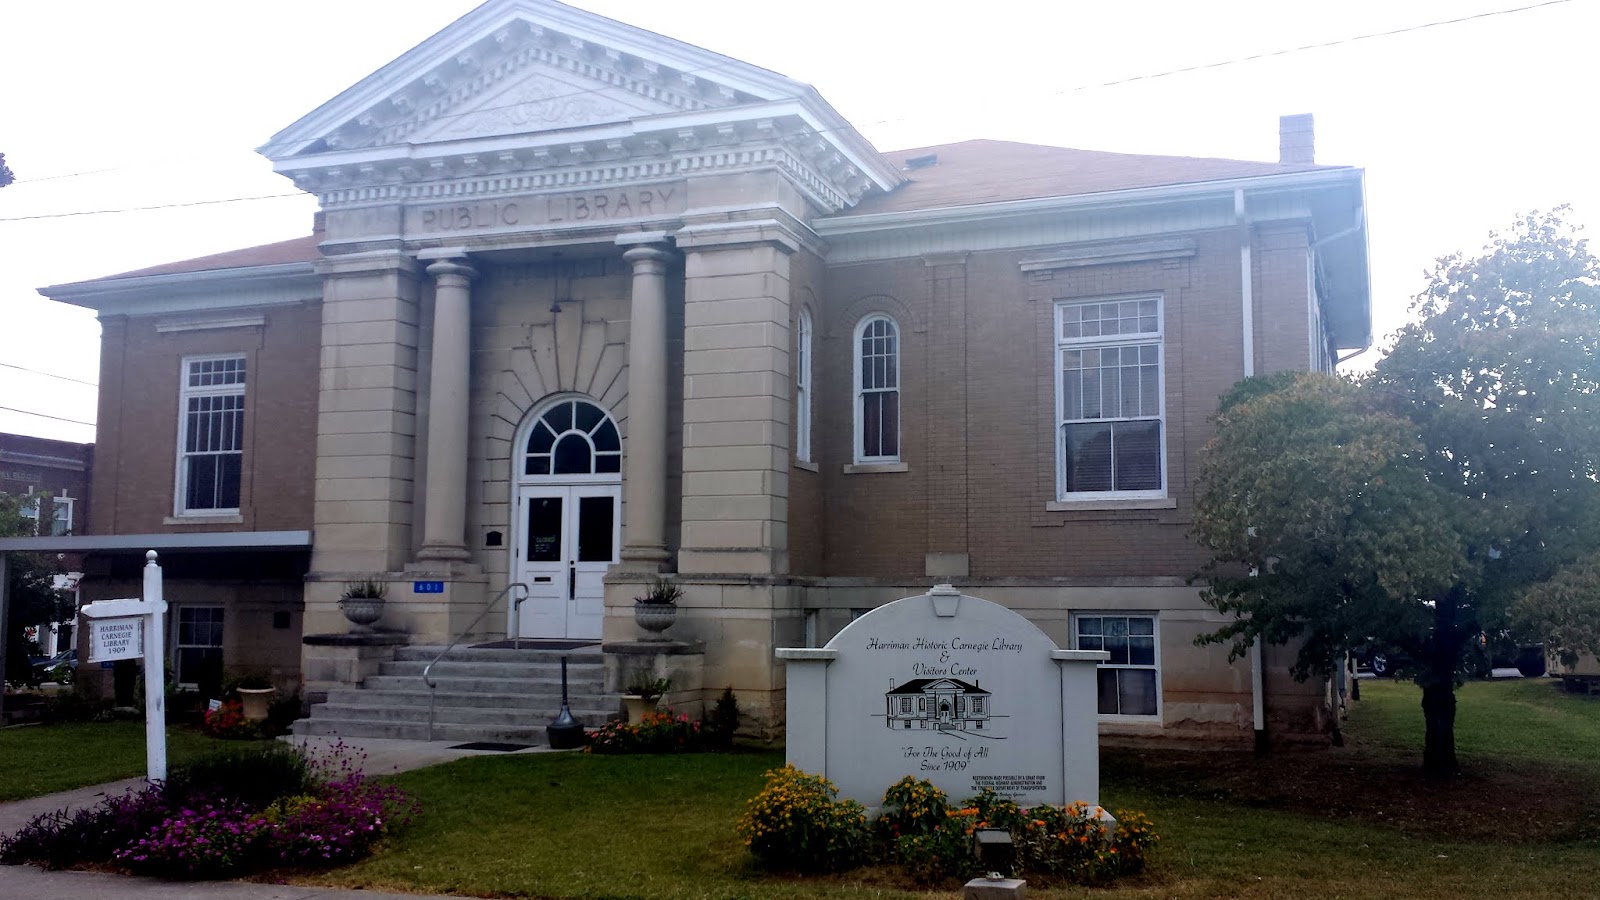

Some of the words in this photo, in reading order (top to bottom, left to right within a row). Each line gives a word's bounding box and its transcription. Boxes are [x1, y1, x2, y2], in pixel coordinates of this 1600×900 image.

[422, 203, 519, 232] PUBLIC
[547, 188, 675, 222] LIBRARY
[100, 624, 133, 632] HARRIMAN
[101, 632, 132, 640] CARNEGIE
[866, 637, 910, 650] Harriman
[912, 637, 948, 650] Historic
[951, 637, 989, 654] Carnegie
[991, 637, 1023, 654] Library
[939, 650, 950, 664] &
[912, 662, 947, 676] Visitors
[950, 662, 978, 676] Center
[922, 746, 938, 758] The
[940, 745, 962, 760] Good
[963, 746, 972, 760] of
[973, 746, 989, 758] All
[920, 759, 941, 771] Since
